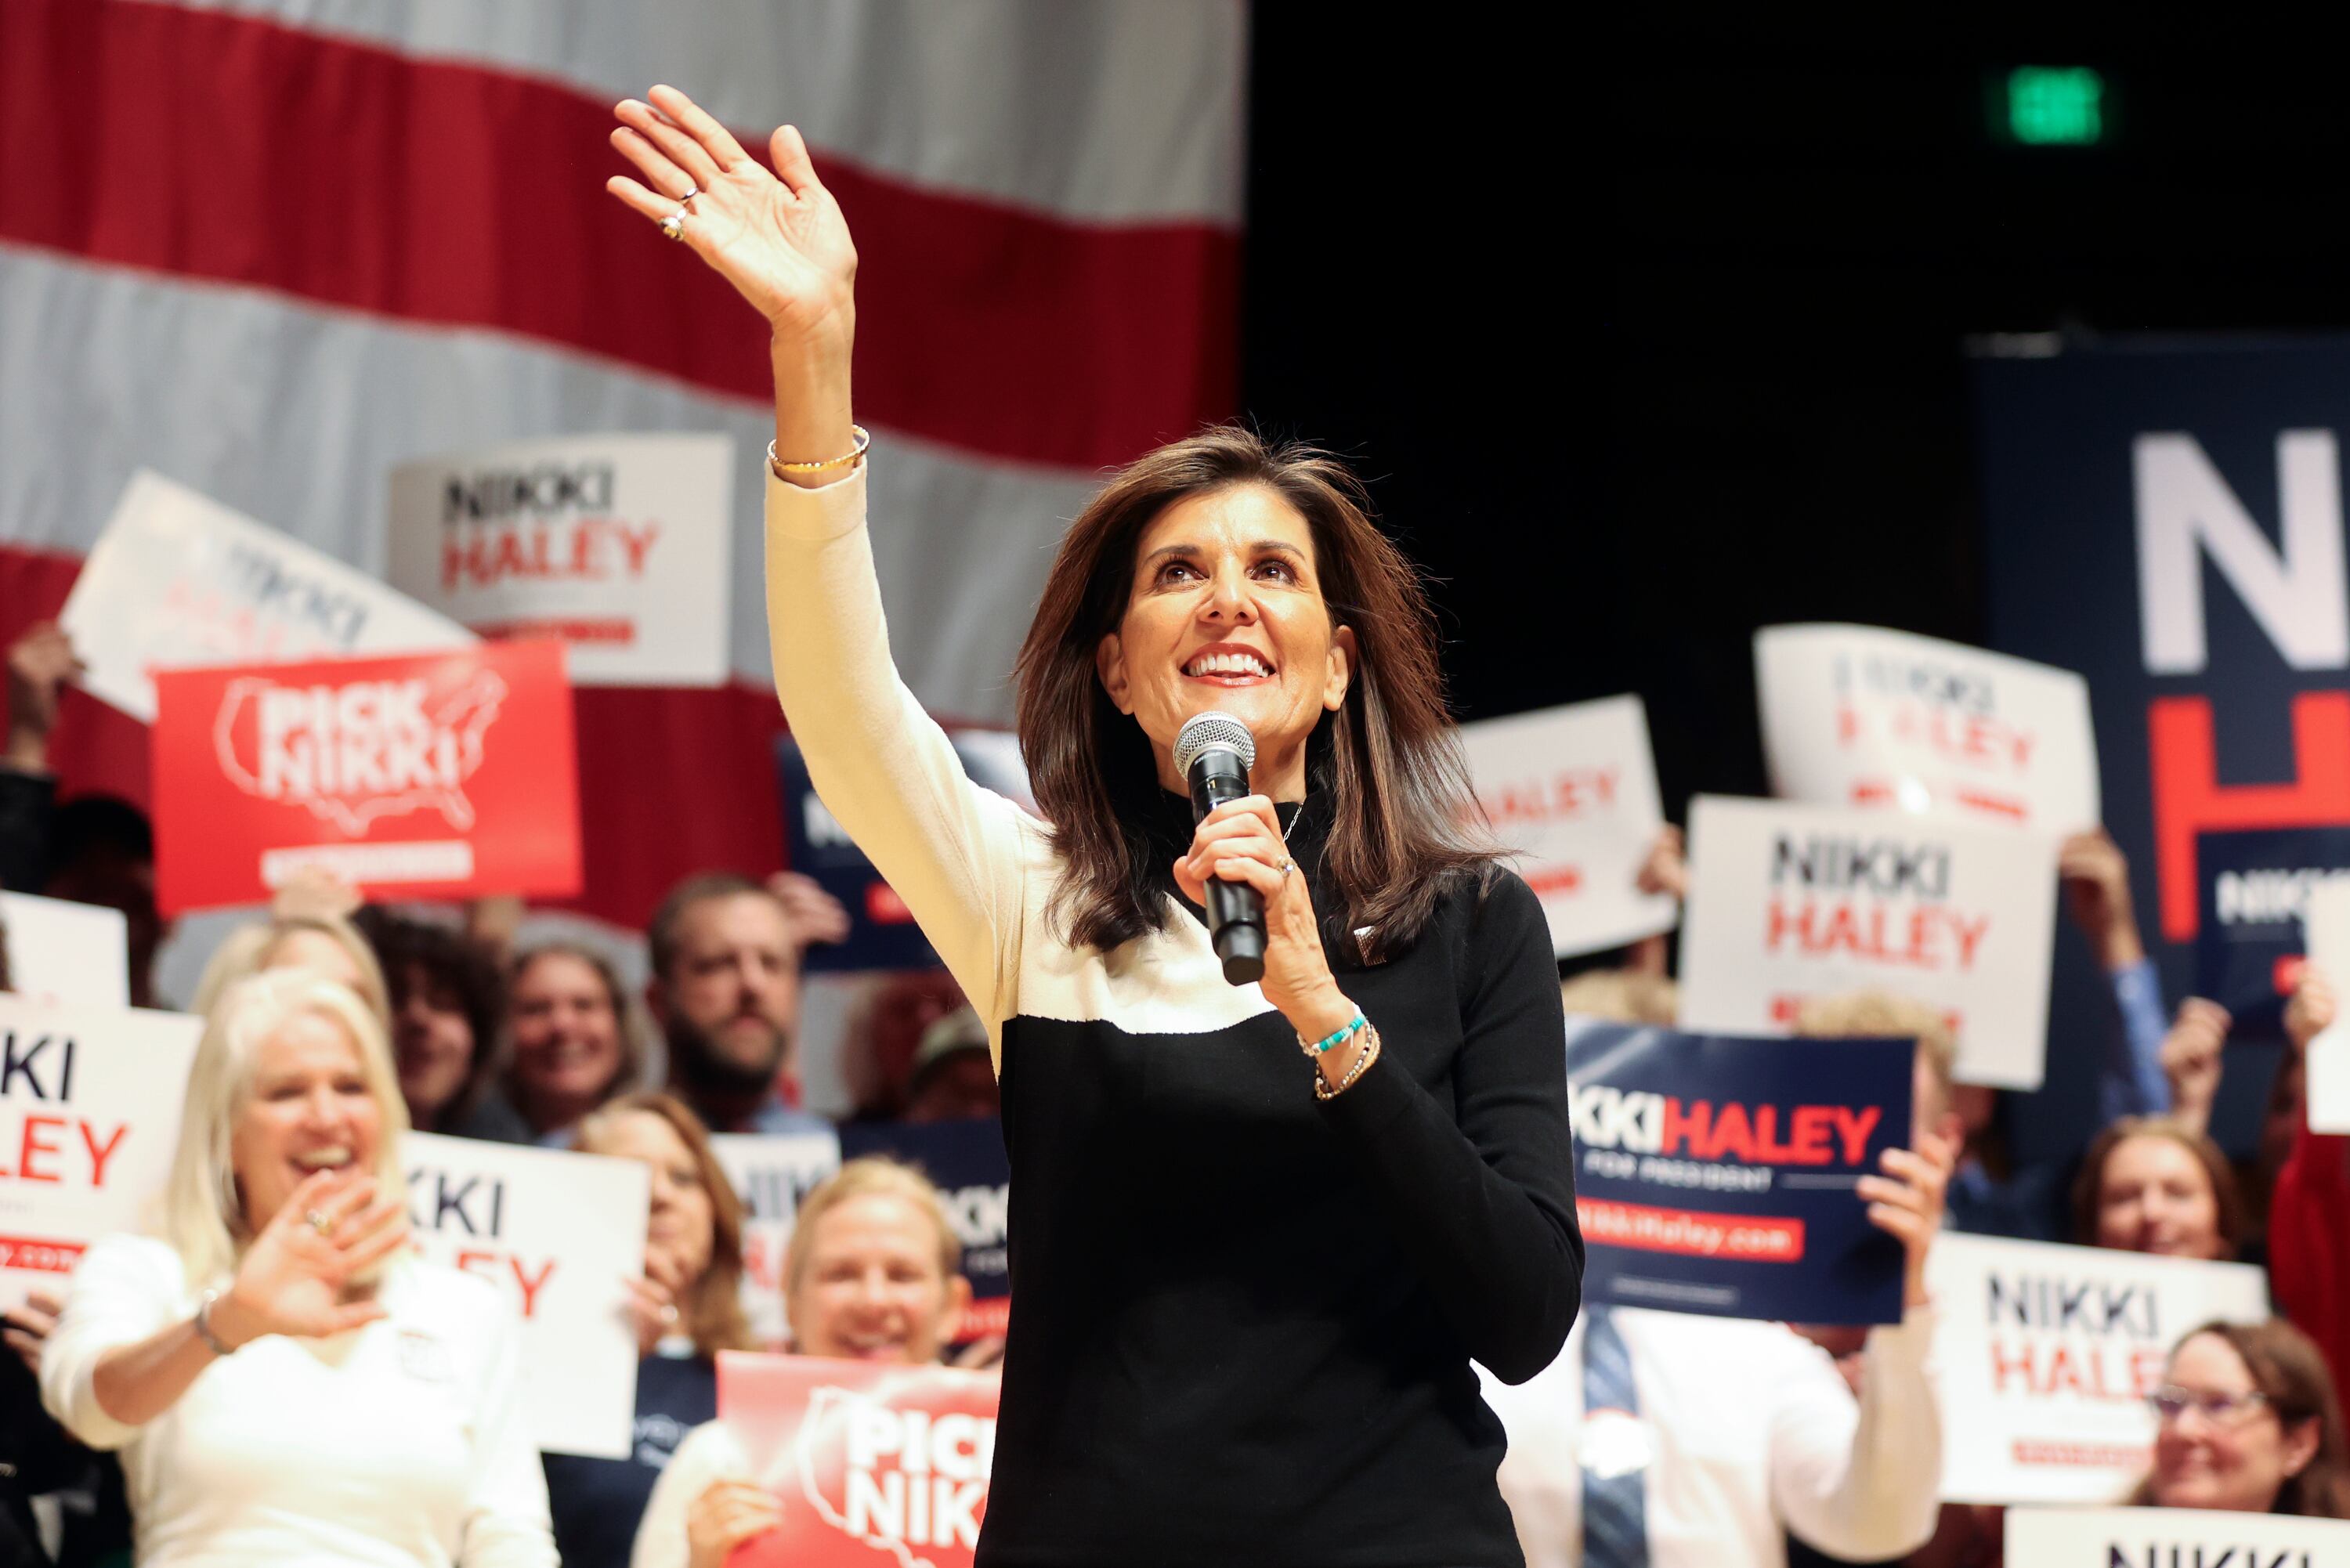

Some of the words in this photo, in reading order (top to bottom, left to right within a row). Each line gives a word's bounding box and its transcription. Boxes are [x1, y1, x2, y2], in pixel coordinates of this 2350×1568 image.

[442, 462, 615, 523] NIKKI
[440, 518, 663, 592] HALEY
[258, 680, 427, 736] PICK
[257, 724, 459, 799] NIKKI
[1769, 835, 1950, 899] NIKKI
[1766, 897, 1991, 971] HALEY
[0, 1115, 129, 1187] EY
[1583, 1149, 1637, 1180] FOR
[1639, 1155, 1772, 1194] PRESIDENT
[1988, 1274, 2159, 1338] NIKKI
